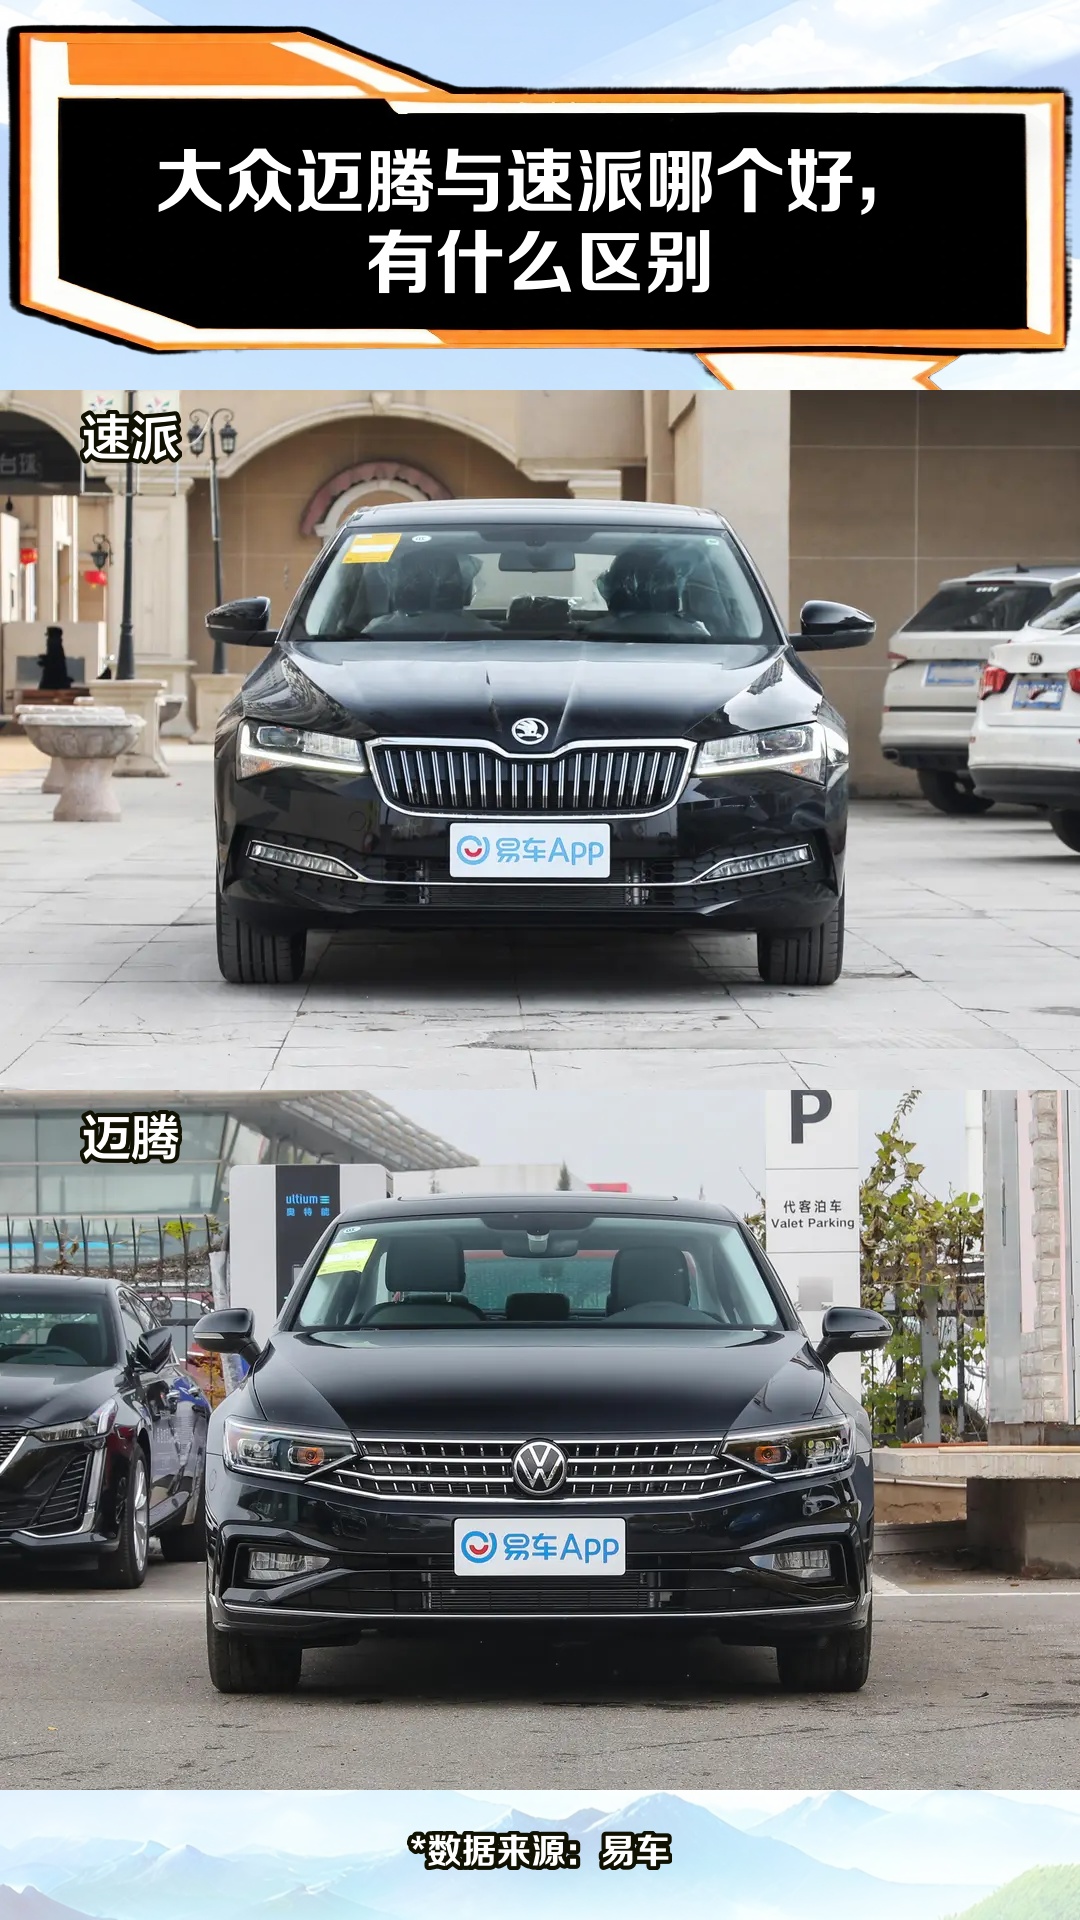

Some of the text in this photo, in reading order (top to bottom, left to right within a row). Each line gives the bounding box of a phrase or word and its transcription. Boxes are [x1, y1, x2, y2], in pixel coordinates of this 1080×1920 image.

[496, 837, 604, 866] 易车App
[790, 1090, 833, 1144] P
[285, 1193, 318, 1204] ultium
[783, 1200, 842, 1214] 代客泊车
[771, 1217, 855, 1230] Valet Parking
[503, 1532, 620, 1564] 易车App
